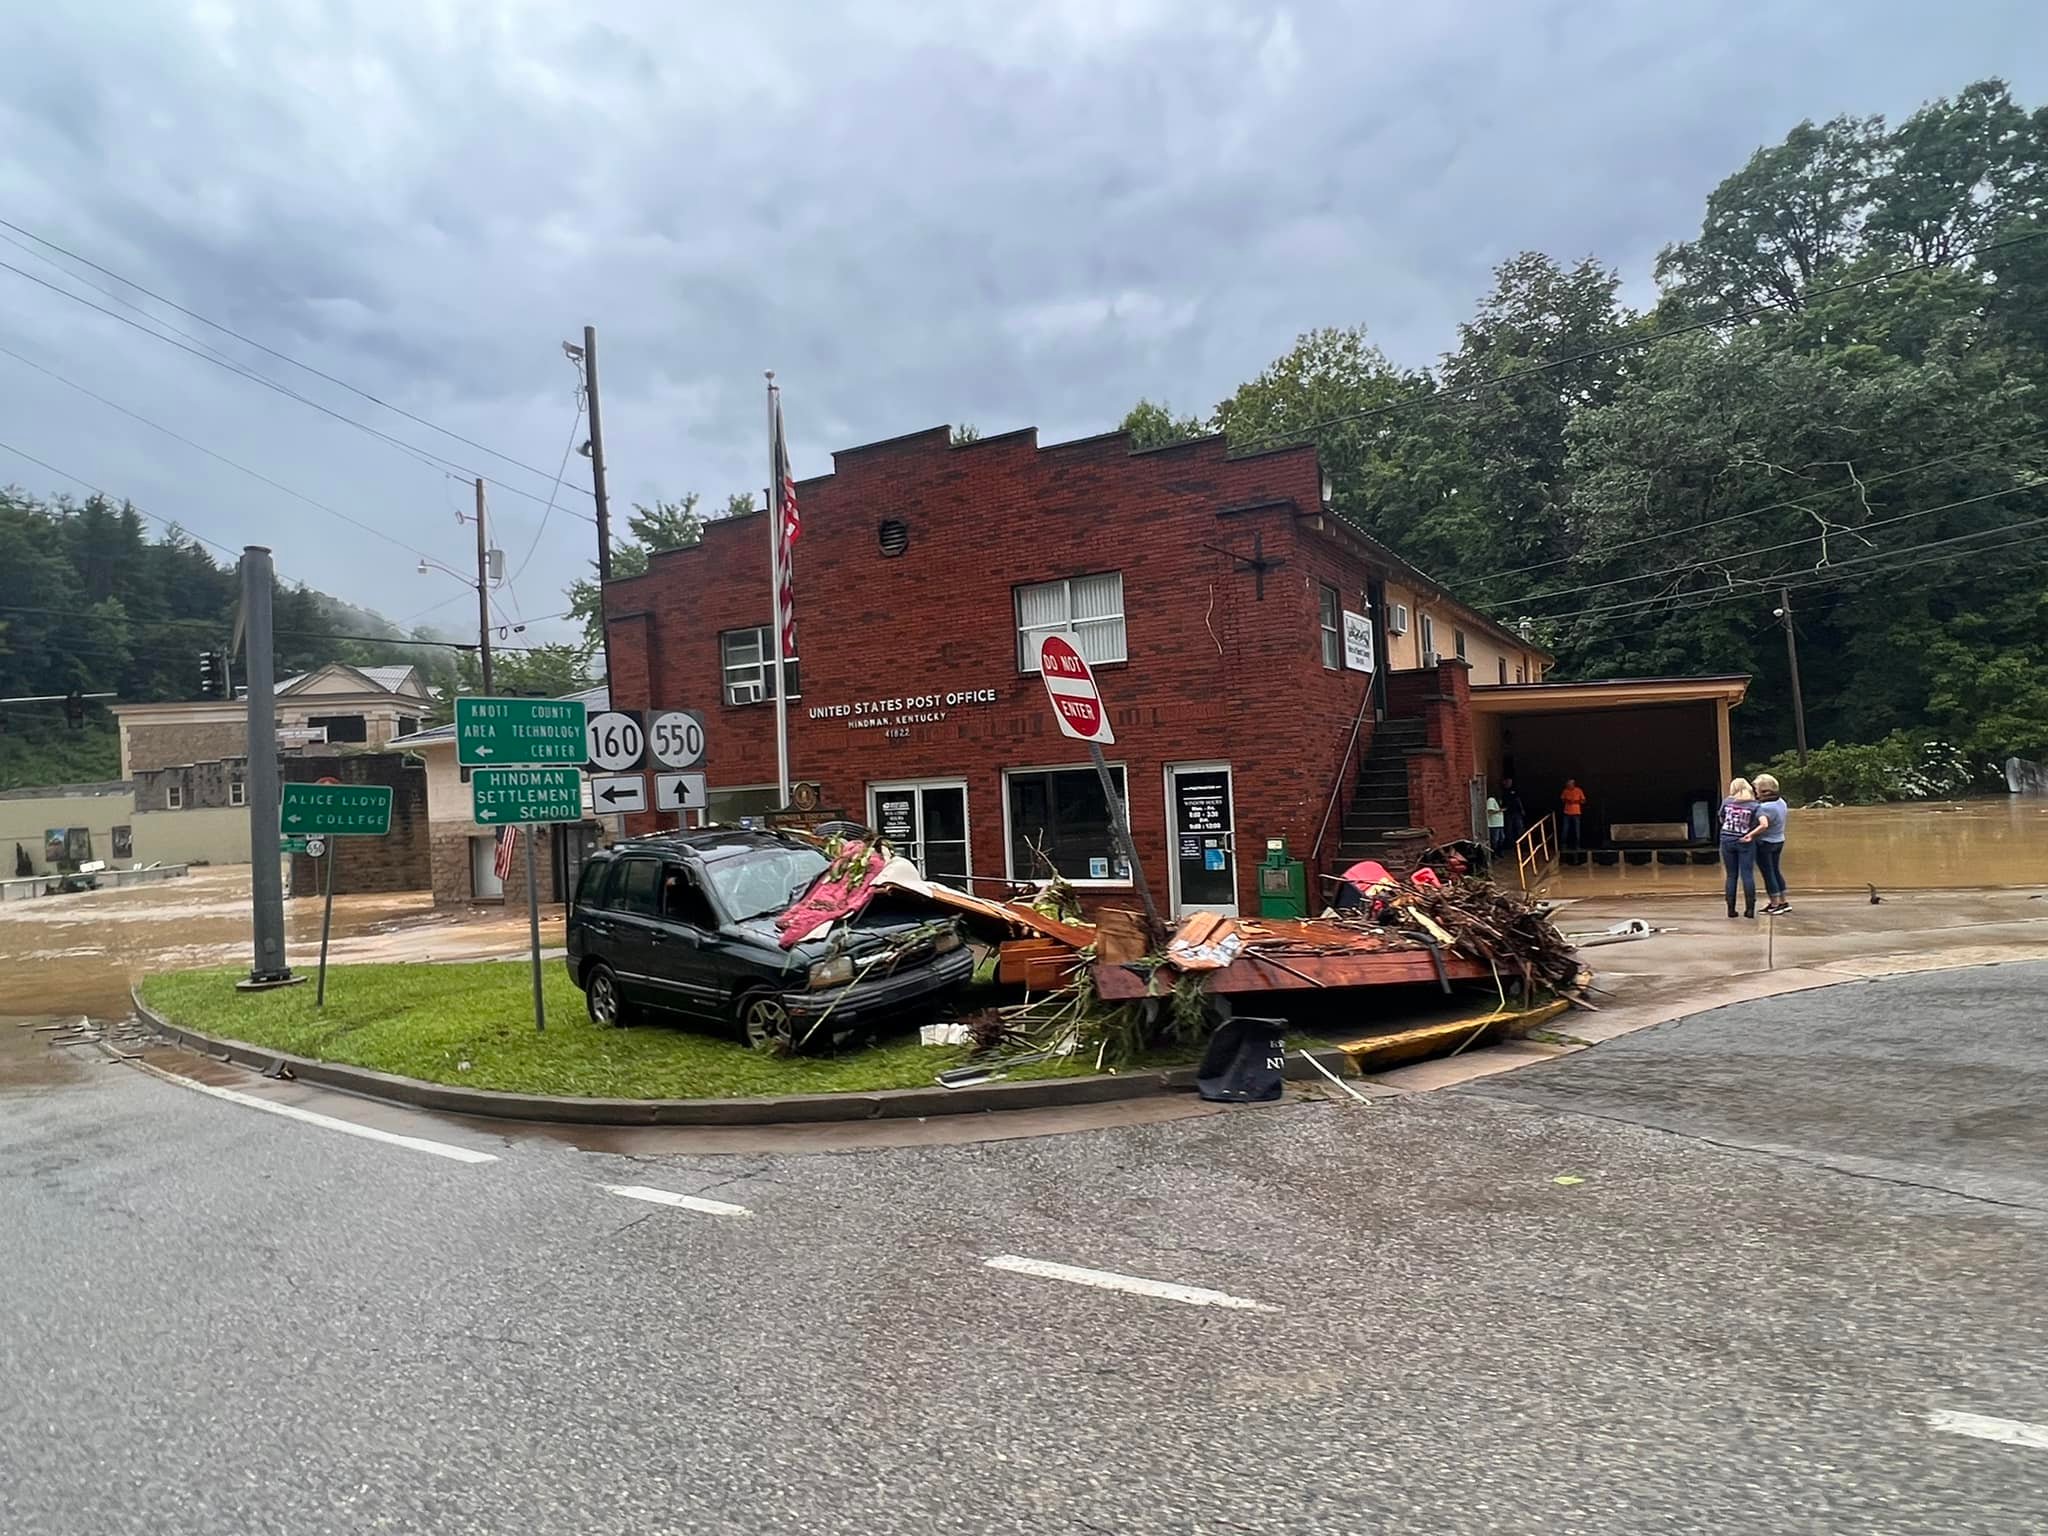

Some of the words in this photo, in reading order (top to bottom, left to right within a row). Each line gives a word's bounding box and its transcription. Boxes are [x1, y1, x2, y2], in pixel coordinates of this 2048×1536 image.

[1043, 654, 1059, 671] DO
[1060, 655, 1082, 673] NOT
[471, 704, 508, 718] KNOTT
[531, 705, 572, 719] COUNTY
[809, 704, 851, 720] UNITED
[854, 698, 903, 715] STATES
[906, 694, 942, 710] POST
[946, 689, 996, 705] OFFICE
[1061, 701, 1095, 720] ENTER
[895, 712, 947, 725] KENTUCKY
[464, 724, 496, 738] AREA
[512, 724, 580, 738] TECHNOLOGY
[591, 725, 638, 759] 160
[656, 724, 700, 756] 550
[530, 744, 576, 758] CENTER
[489, 772, 565, 786] HINDMAN
[287, 794, 334, 805] ALICE
[341, 796, 387, 807] LLOYD
[476, 788, 578, 804] SETTLEMENT
[519, 805, 578, 819] SCHOOL
[315, 814, 385, 825] COLLEGE
